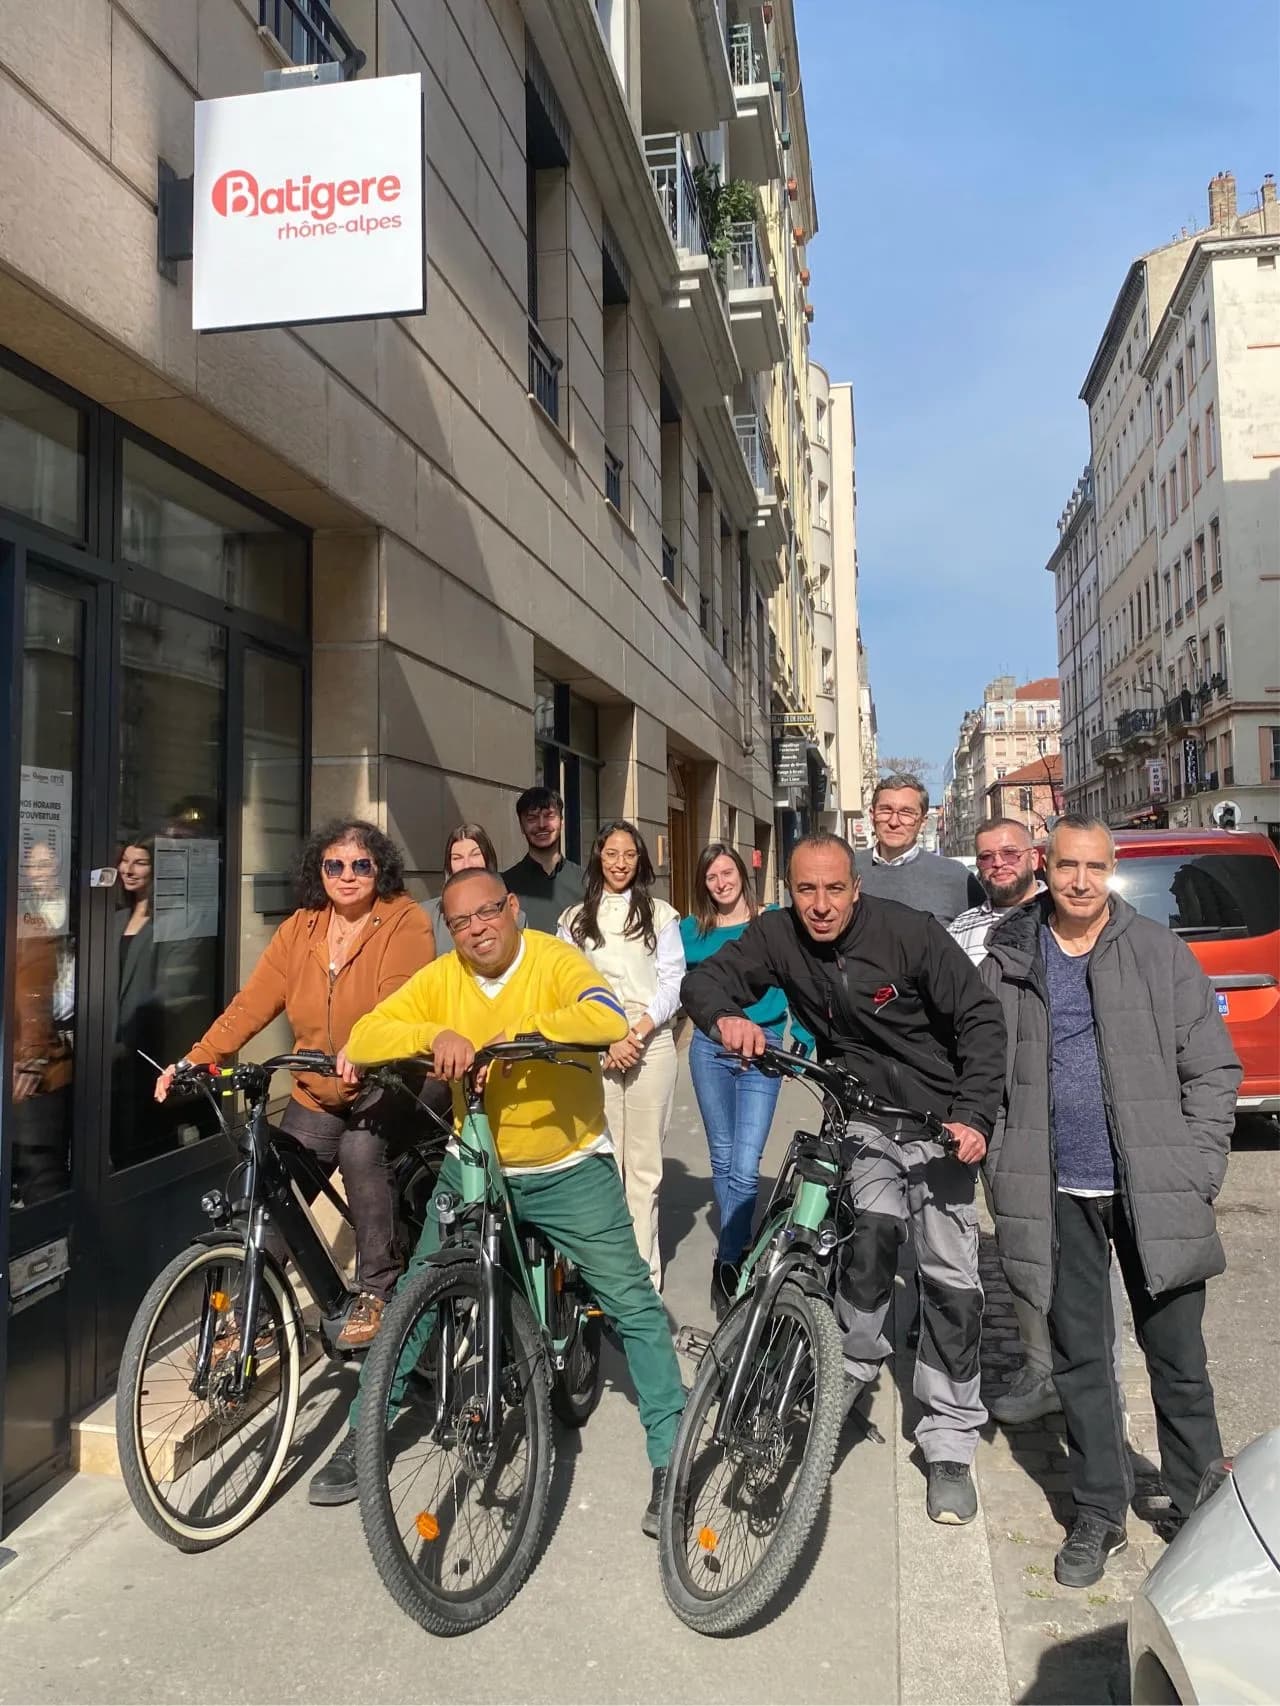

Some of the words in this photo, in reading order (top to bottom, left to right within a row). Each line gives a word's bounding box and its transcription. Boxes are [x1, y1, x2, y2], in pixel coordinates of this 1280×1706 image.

[212, 169, 401, 220] Batigere
[278, 213, 402, 241] rhône-alpes
[33, 801, 61, 810] HORAIRES
[1219, 1004, 1227, 1013] 69
